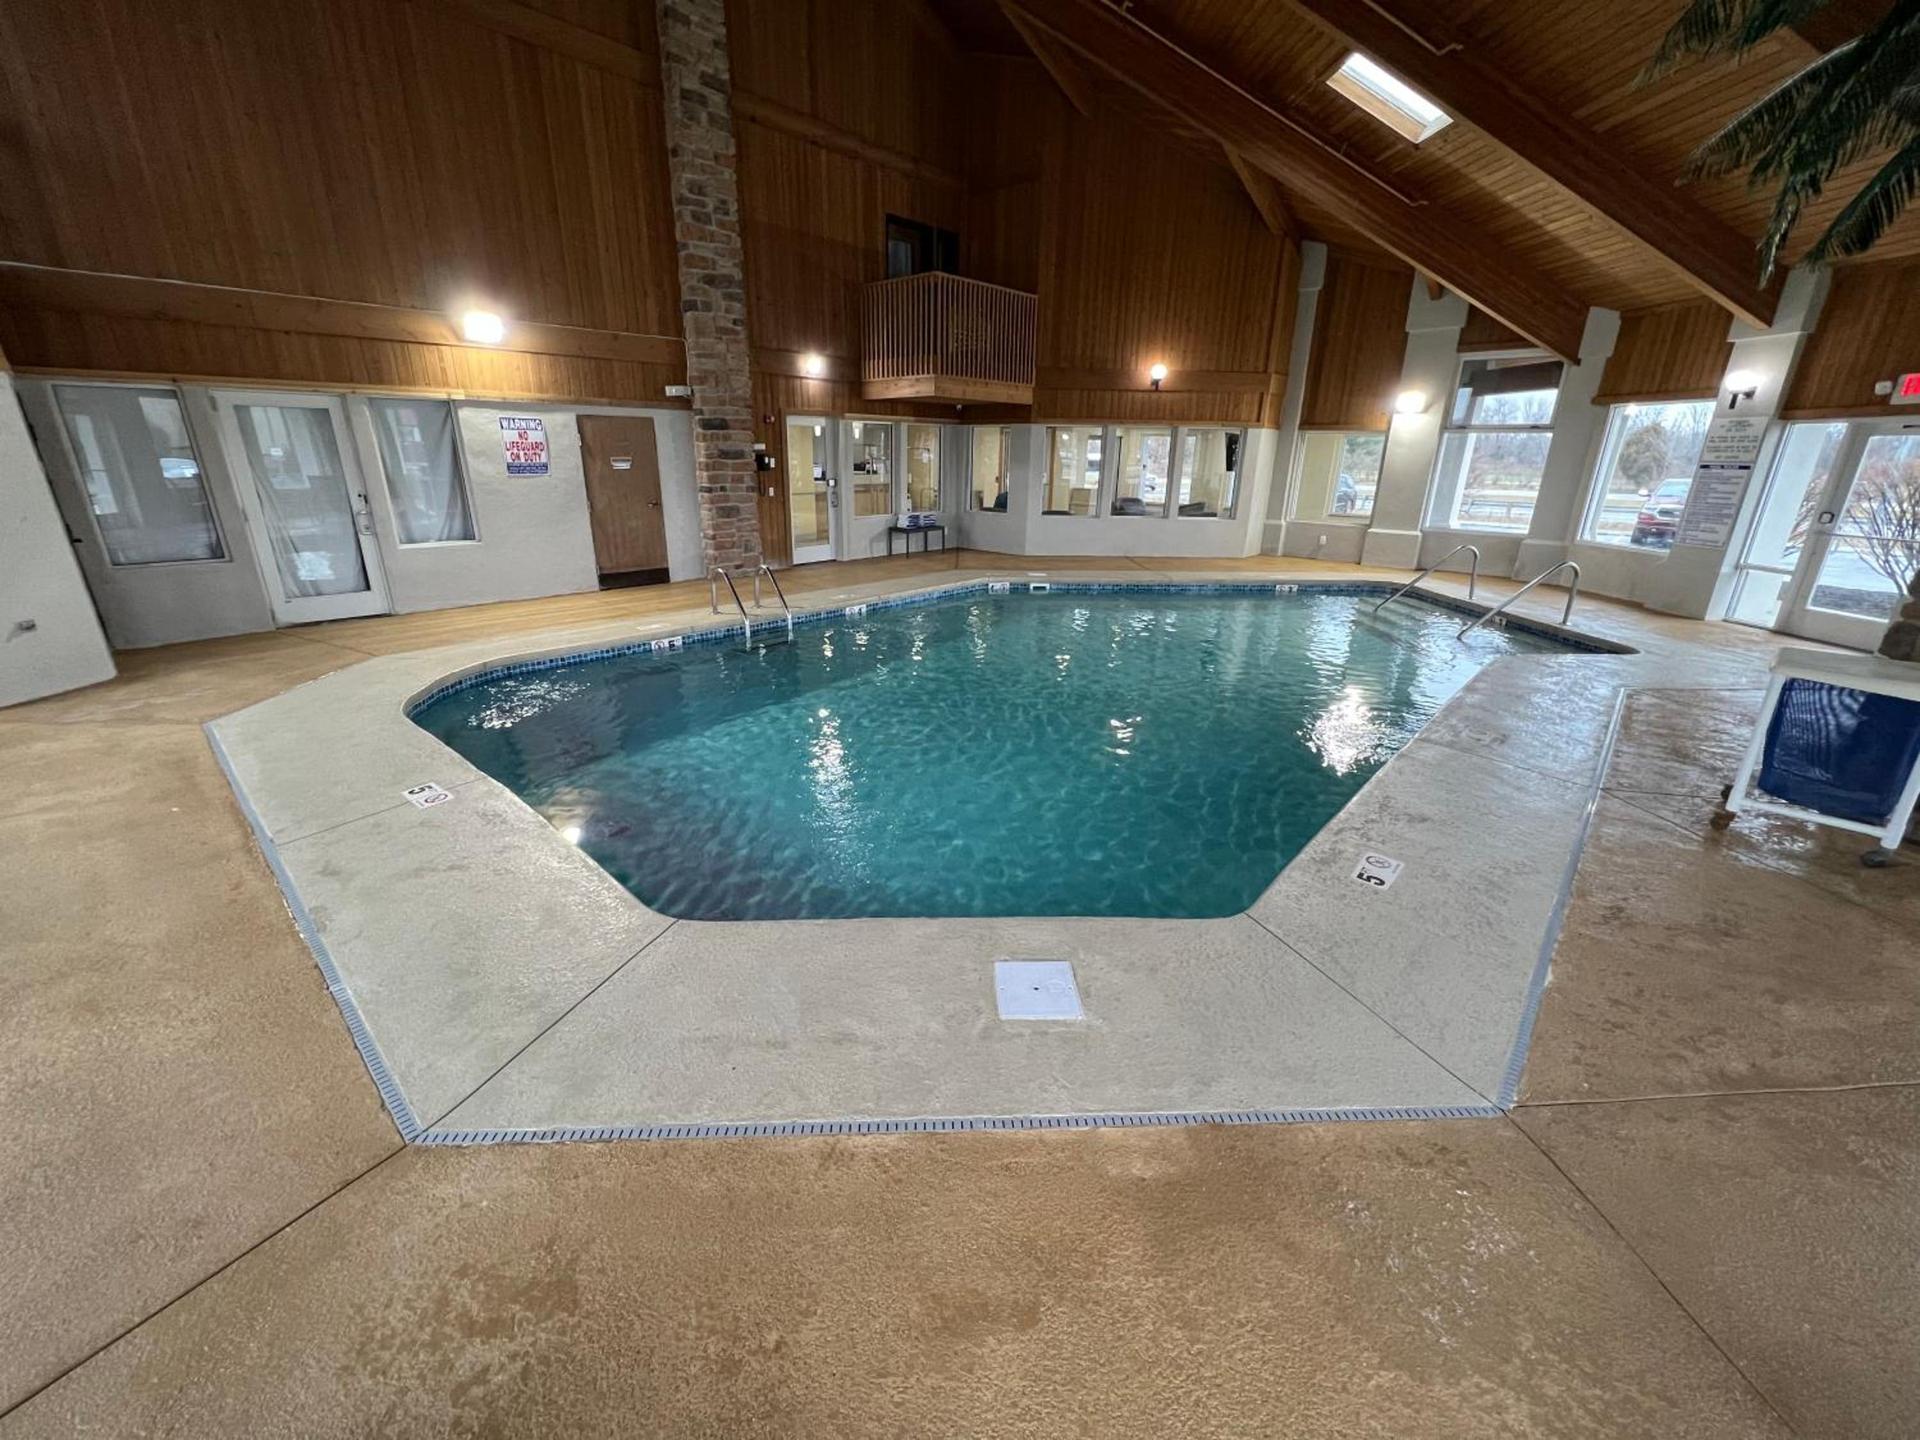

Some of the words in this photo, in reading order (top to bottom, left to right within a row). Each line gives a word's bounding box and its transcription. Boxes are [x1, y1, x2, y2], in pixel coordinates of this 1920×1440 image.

[500, 418, 543, 430] WARNING
[517, 430, 529, 441] NO
[505, 441, 545, 452] LIFEGUARD
[510, 451, 522, 462] ON
[523, 452, 542, 462] DUTY
[408, 785, 433, 795] 5
[1356, 871, 1386, 886] 5
